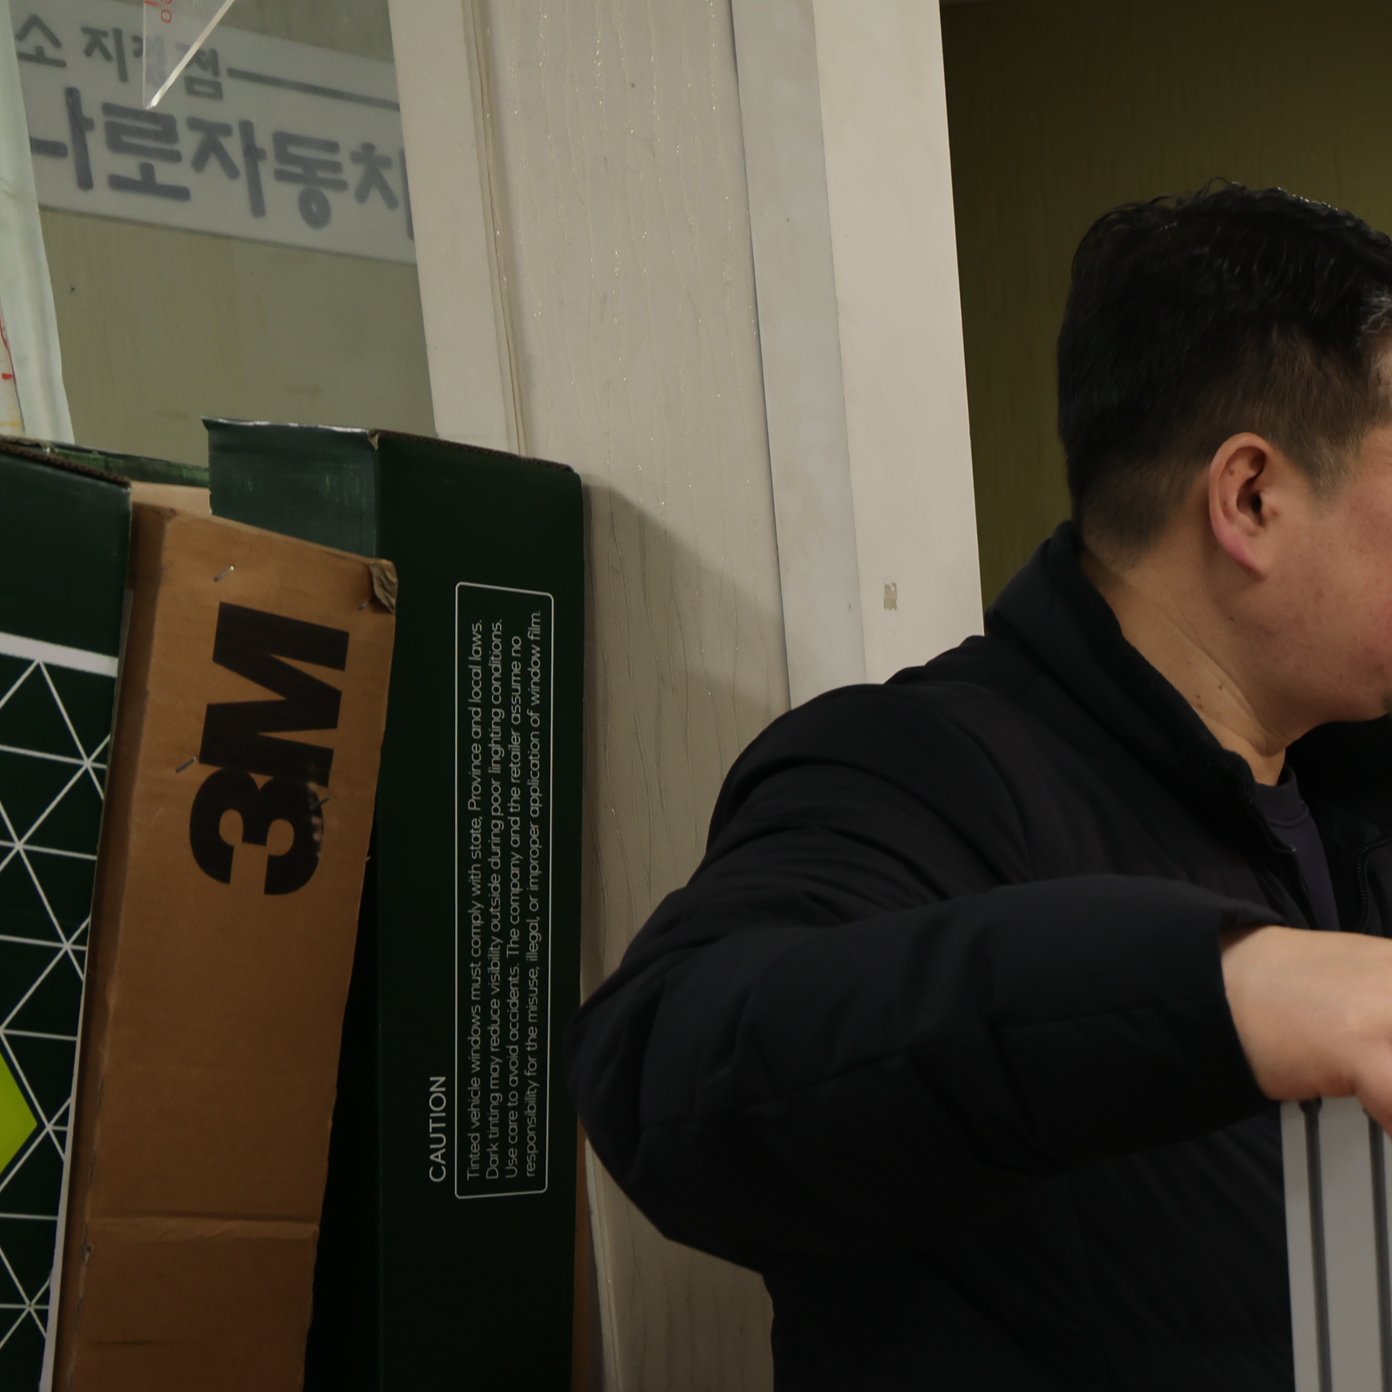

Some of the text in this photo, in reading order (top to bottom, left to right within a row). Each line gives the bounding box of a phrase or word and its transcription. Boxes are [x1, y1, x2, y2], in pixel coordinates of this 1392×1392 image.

[189, 601, 350, 896] 3M
[467, 620, 484, 1180] Tinted vehicle windows must comply with state, Province and local laws.
[486, 619, 505, 1179] Dark tinting may reduce visibility outside during poor linghting conditions.
[505, 636, 523, 1178] Use care to avoid accidents. The company and the retailer assume no
[524, 611, 542, 1176] responsibility for the misuse, illegal, or improper application of window film.
[429, 1076, 446, 1182] CAUTION
